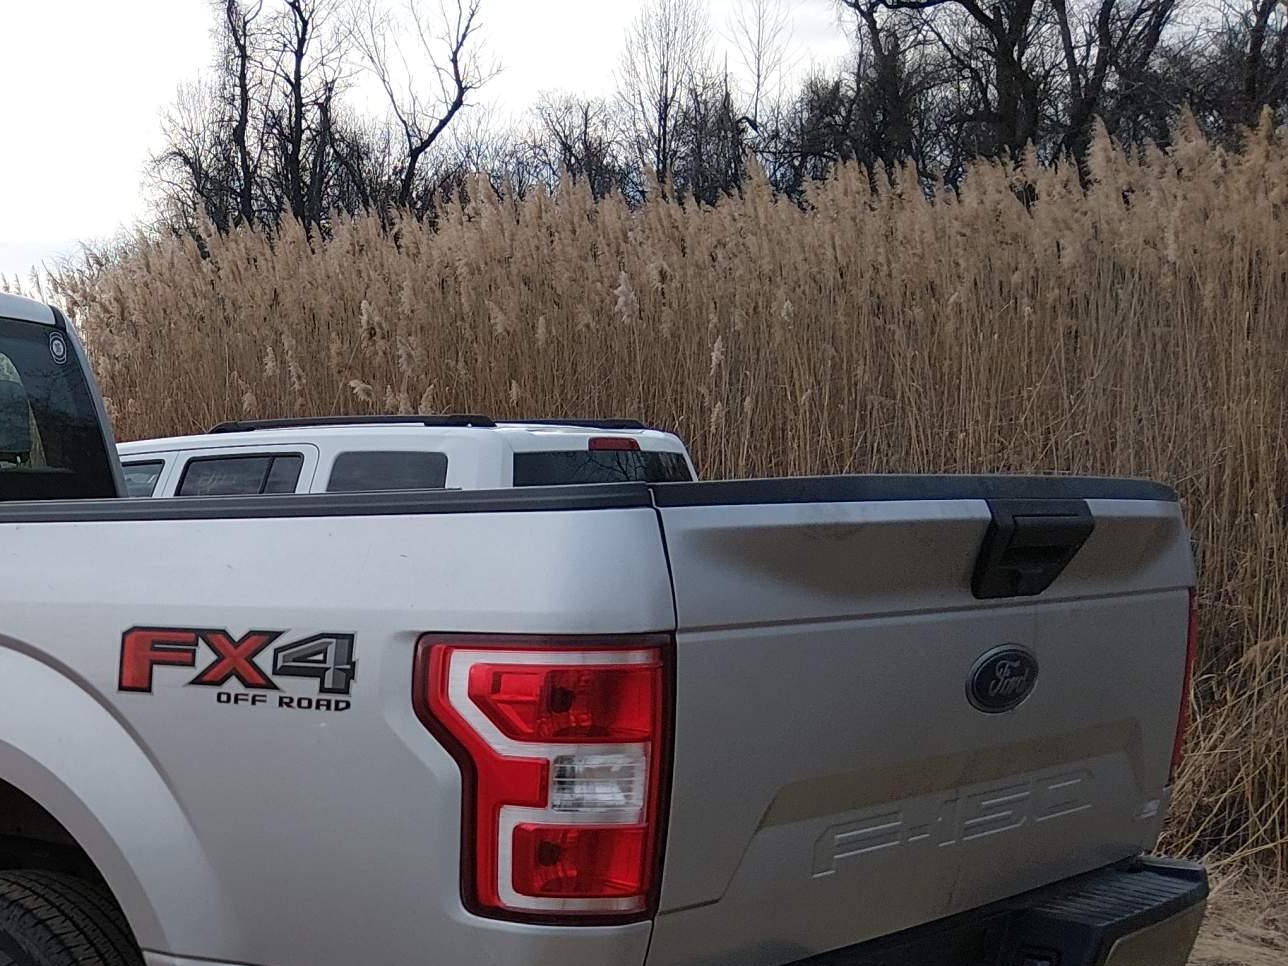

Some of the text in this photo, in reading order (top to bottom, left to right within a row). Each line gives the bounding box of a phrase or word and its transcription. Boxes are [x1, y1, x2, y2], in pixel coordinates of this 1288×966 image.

[117, 625, 357, 696] FX4
[216, 691, 352, 712] OFF ROAD
[811, 767, 1094, 879] F-150
